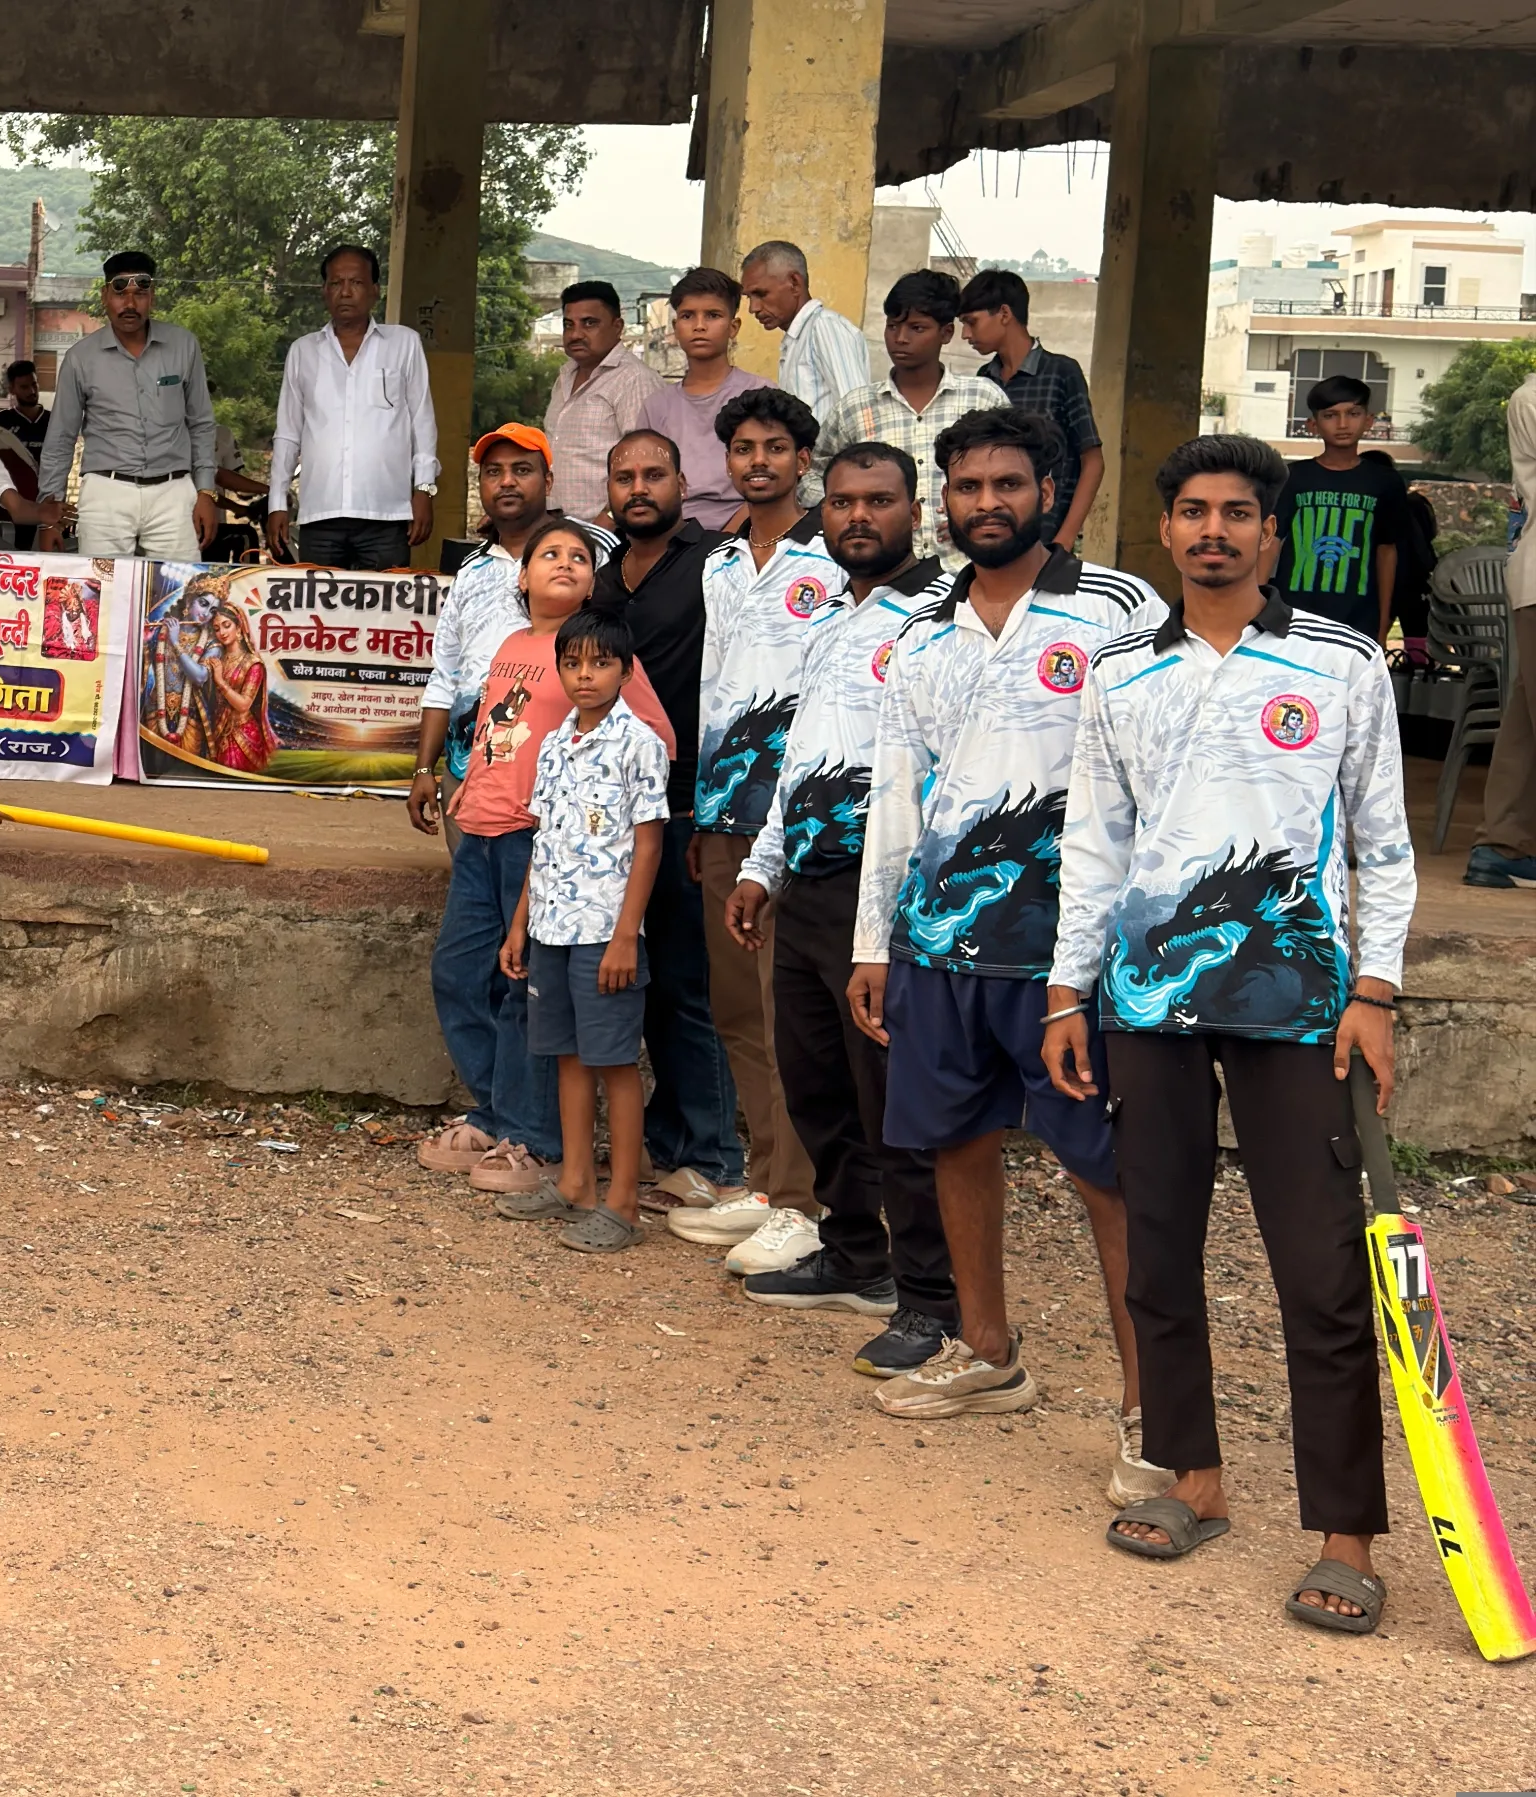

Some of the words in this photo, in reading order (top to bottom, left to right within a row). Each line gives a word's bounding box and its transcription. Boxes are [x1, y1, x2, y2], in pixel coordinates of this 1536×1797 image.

[1315, 491, 1340, 506] HERE
[1341, 493, 1360, 508] FOR
[266, 569, 450, 615] द्वारिकाधी
[259, 613, 359, 653] क्रिकेट
[292, 663, 313, 676] खेल
[315, 666, 346, 678] भावना
[358, 669, 386, 681] एकता
[489, 662, 547, 682] ZHIZHI
[338, 691, 354, 702] खेल
[357, 694, 381, 704] भावना
[384, 693, 395, 705] को
[305, 702, 320, 713] और
[323, 704, 356, 716] आयोजन
[359, 705, 371, 716] को
[373, 708, 397, 718] सफल
[1386, 1243, 1428, 1299] 77
[1432, 1515, 1463, 1558] 77
